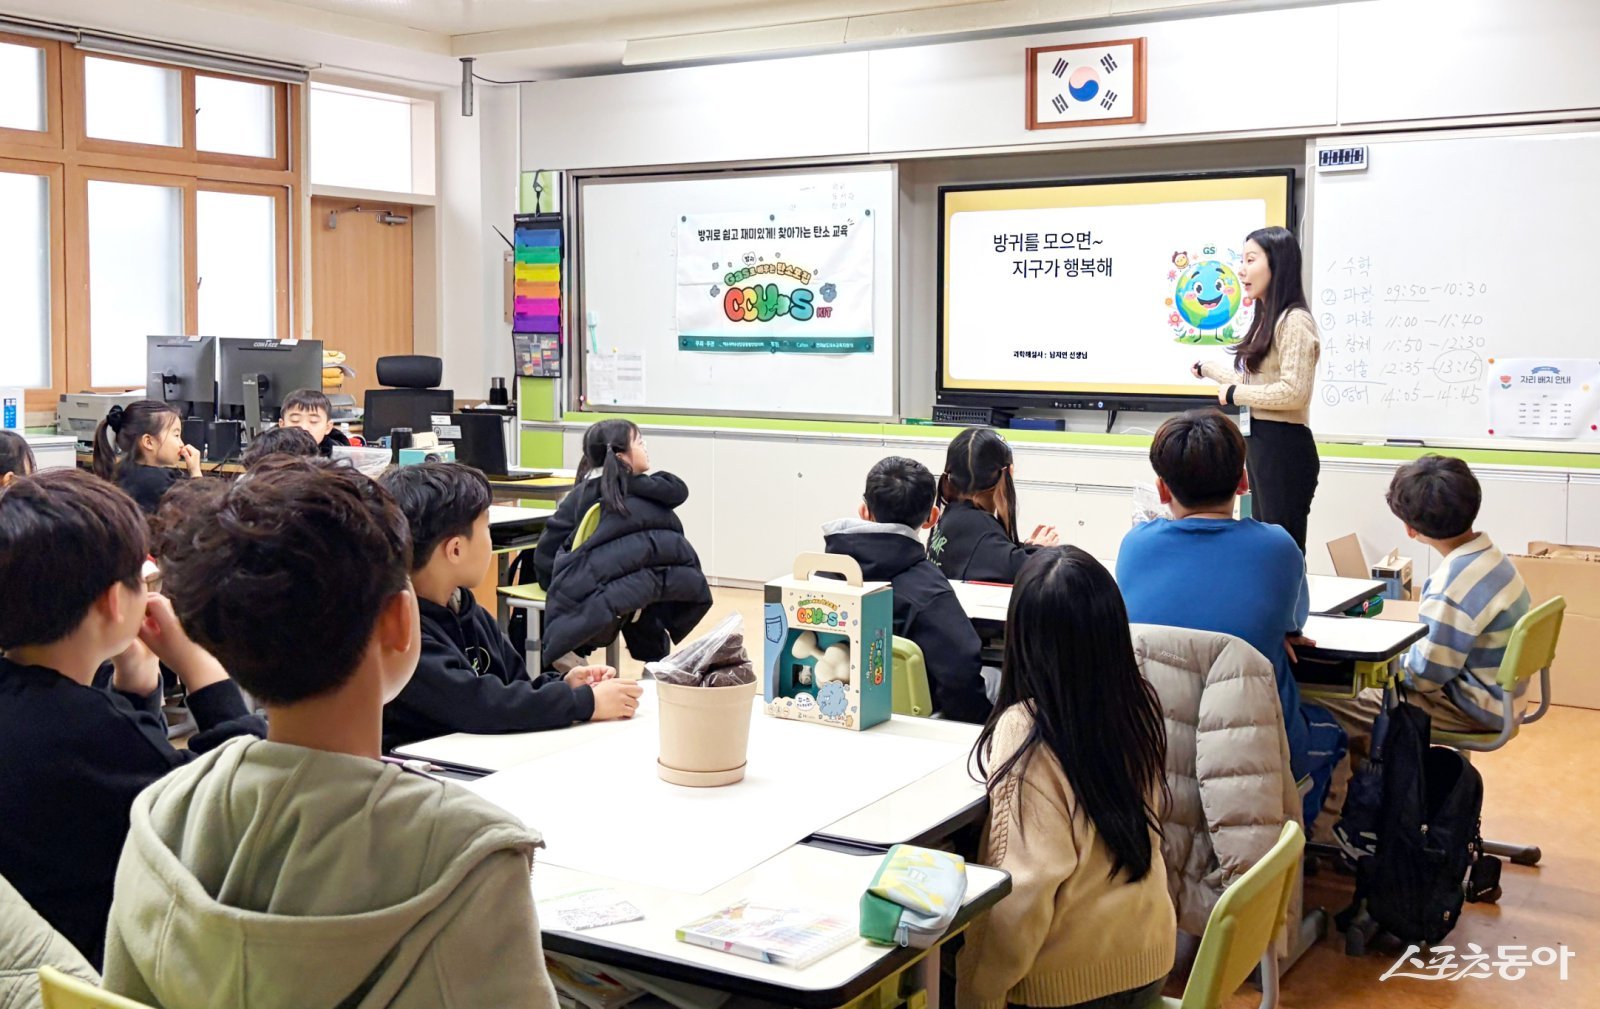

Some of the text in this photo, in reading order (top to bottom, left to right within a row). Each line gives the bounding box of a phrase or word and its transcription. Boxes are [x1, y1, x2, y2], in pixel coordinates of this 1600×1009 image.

[698, 225, 848, 242] 방귀로 쉽고 재미있게! 찾아가는 탄소 교육
[993, 231, 1103, 253] 방귀를 모으면~
[1203, 247, 1216, 255] GS
[1012, 257, 1113, 279] 지구가 행복해
[1342, 256, 1372, 277] 수학
[816, 307, 832, 318] KIT
[1346, 311, 1376, 327] 과학
[1069, 351, 1088, 359] 선생님
[1345, 360, 1368, 378] 미술
[1520, 375, 1571, 384] 자리 배치 안내
[1342, 385, 1368, 404] 영어
